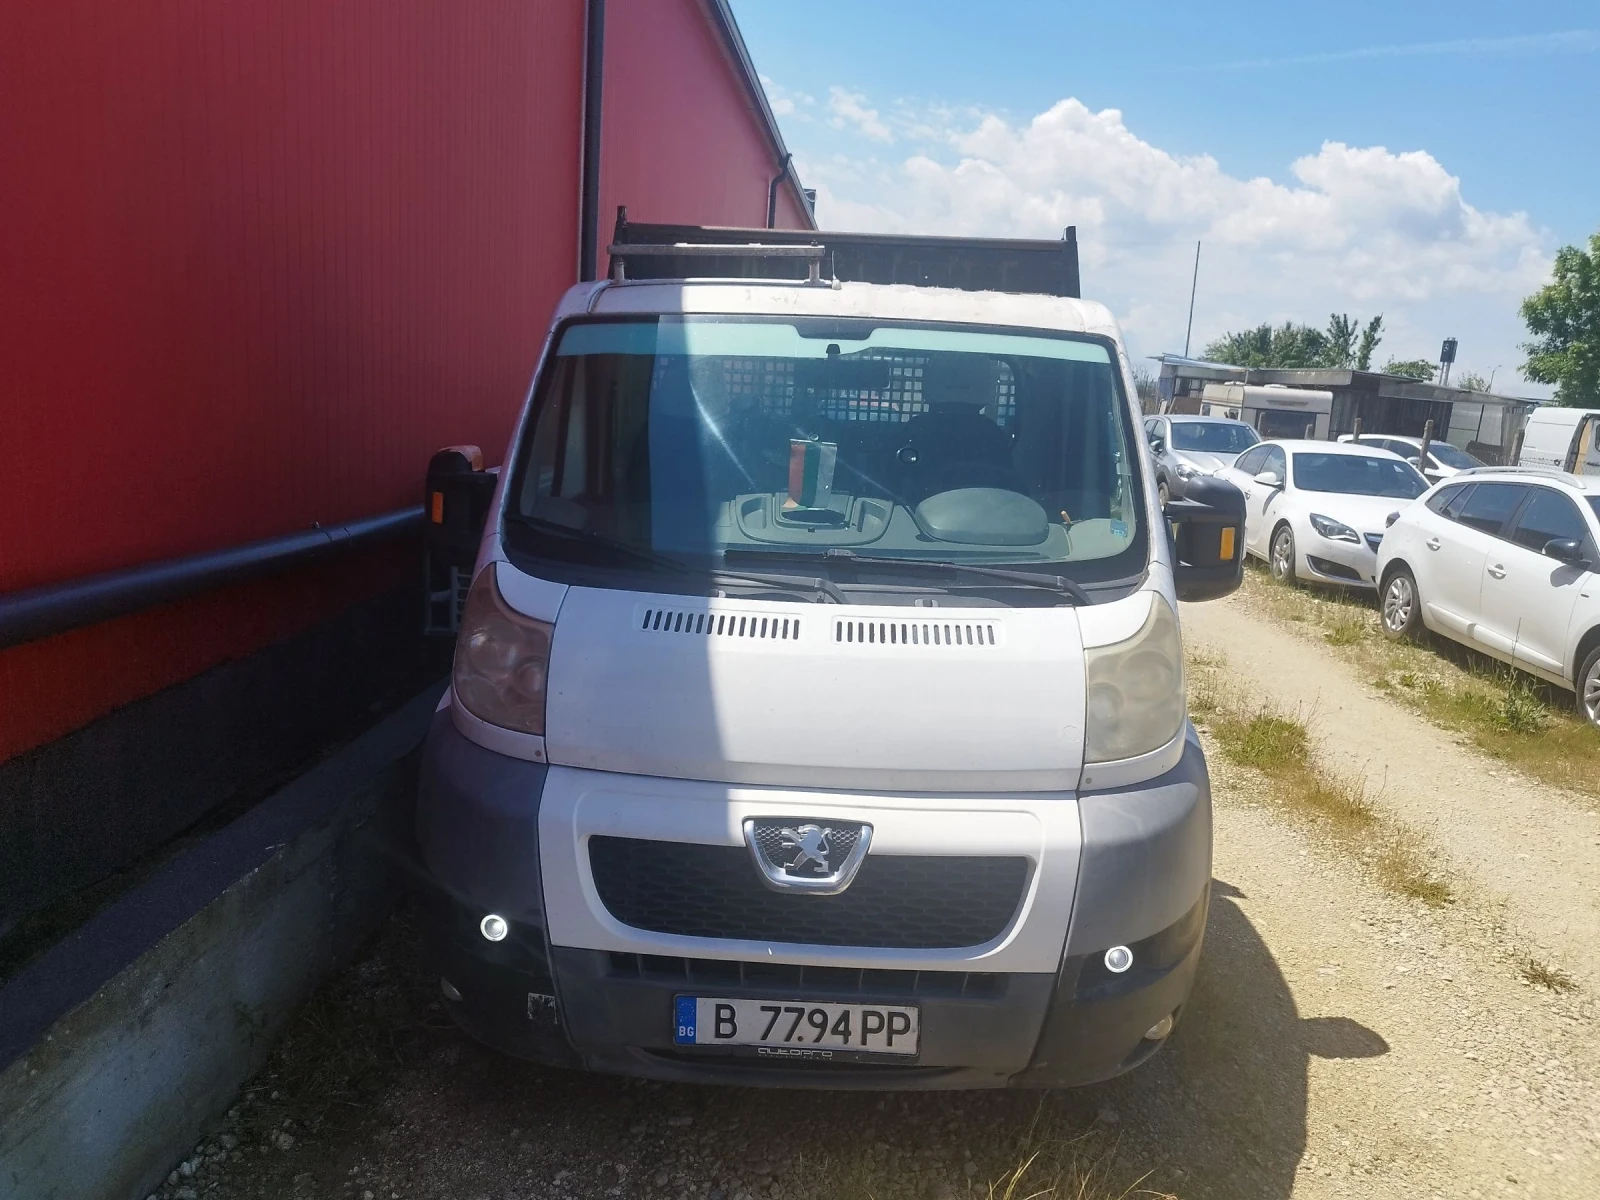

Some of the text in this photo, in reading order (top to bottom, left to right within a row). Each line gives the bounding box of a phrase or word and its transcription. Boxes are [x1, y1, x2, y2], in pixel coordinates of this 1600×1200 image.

[678, 1025, 695, 1037] BG
[714, 1003, 738, 1039] B
[860, 1010, 911, 1047] PP
